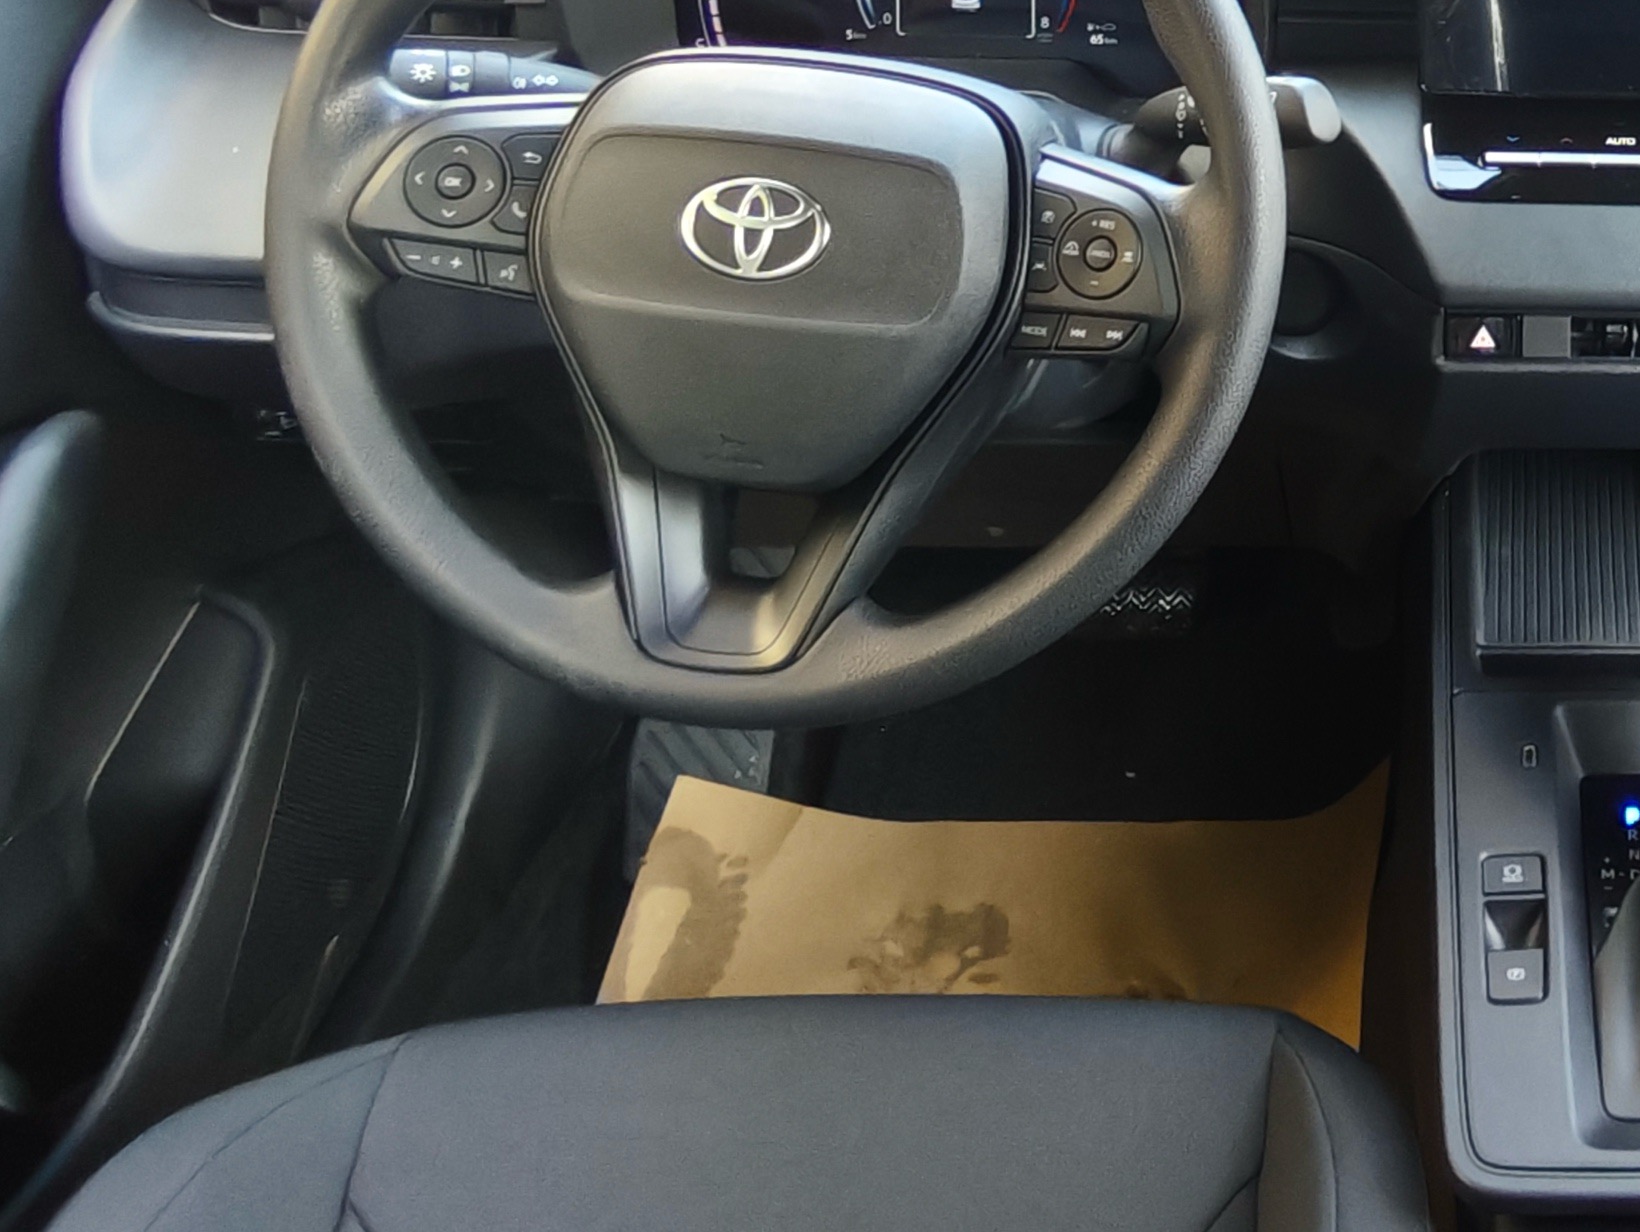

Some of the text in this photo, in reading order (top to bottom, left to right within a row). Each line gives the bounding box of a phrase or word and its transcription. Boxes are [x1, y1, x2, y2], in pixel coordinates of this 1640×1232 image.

[882, 12, 892, 25] 0
[1040, 15, 1050, 29] 8
[1605, 137, 1636, 146] AUTO
[1627, 828, 1639, 841] R
[1629, 848, 1640, 860] N
[1601, 868, 1616, 880] M
